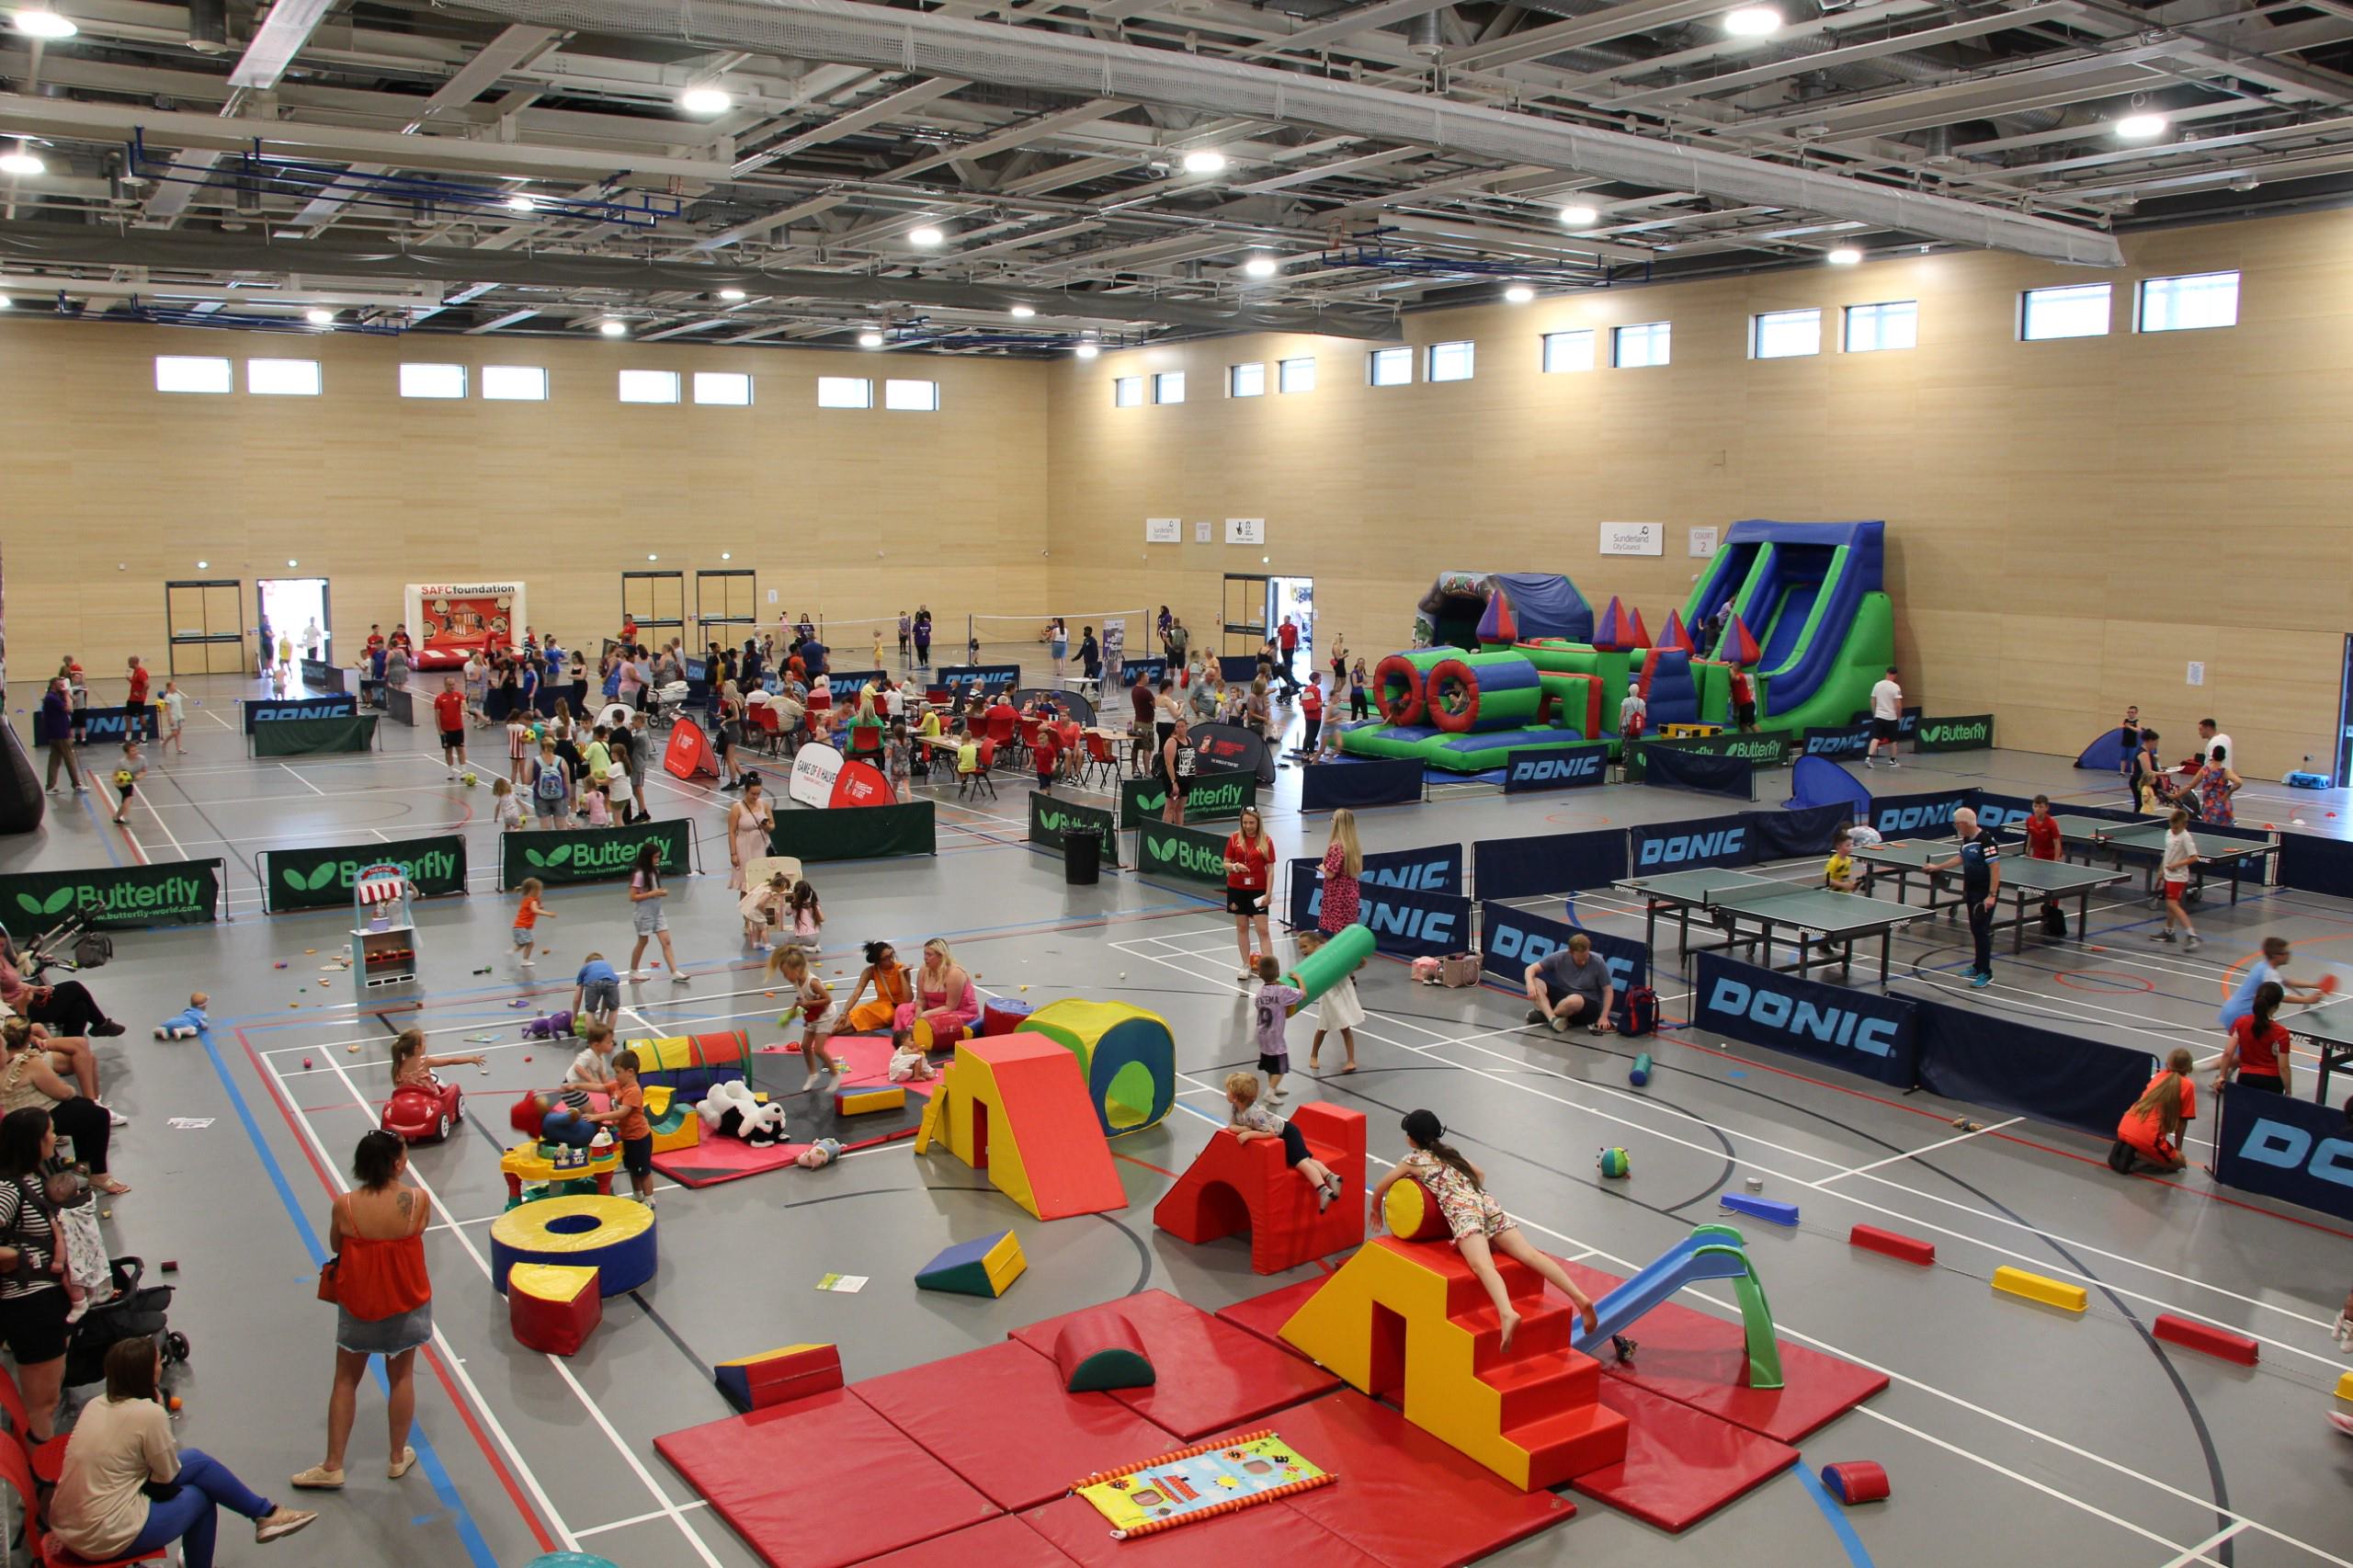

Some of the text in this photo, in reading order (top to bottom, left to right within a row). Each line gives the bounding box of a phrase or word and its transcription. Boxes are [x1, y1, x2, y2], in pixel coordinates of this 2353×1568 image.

[1613, 534, 1649, 542] Sunderland
[1700, 542, 1707, 551] 2
[422, 585, 515, 595] SAFCfoundation
[1941, 722, 1987, 741] Butterfly
[1737, 740, 1781, 757] Butterfly
[797, 760, 812, 775] GAME
[821, 770, 836, 785] HALVE
[1513, 756, 1600, 780] DONIC
[1185, 783, 1243, 807] utterfly
[1178, 841, 1224, 874] Butte
[1641, 828, 1745, 865] DONIC
[339, 851, 456, 888] Berfly
[77, 877, 199, 911] Butterfly
[2018, 886, 2047, 896] DONIC
[1798, 926, 1827, 937] DONIC
[1491, 924, 1634, 992] DOC
[1708, 977, 1898, 1057] DONIC
